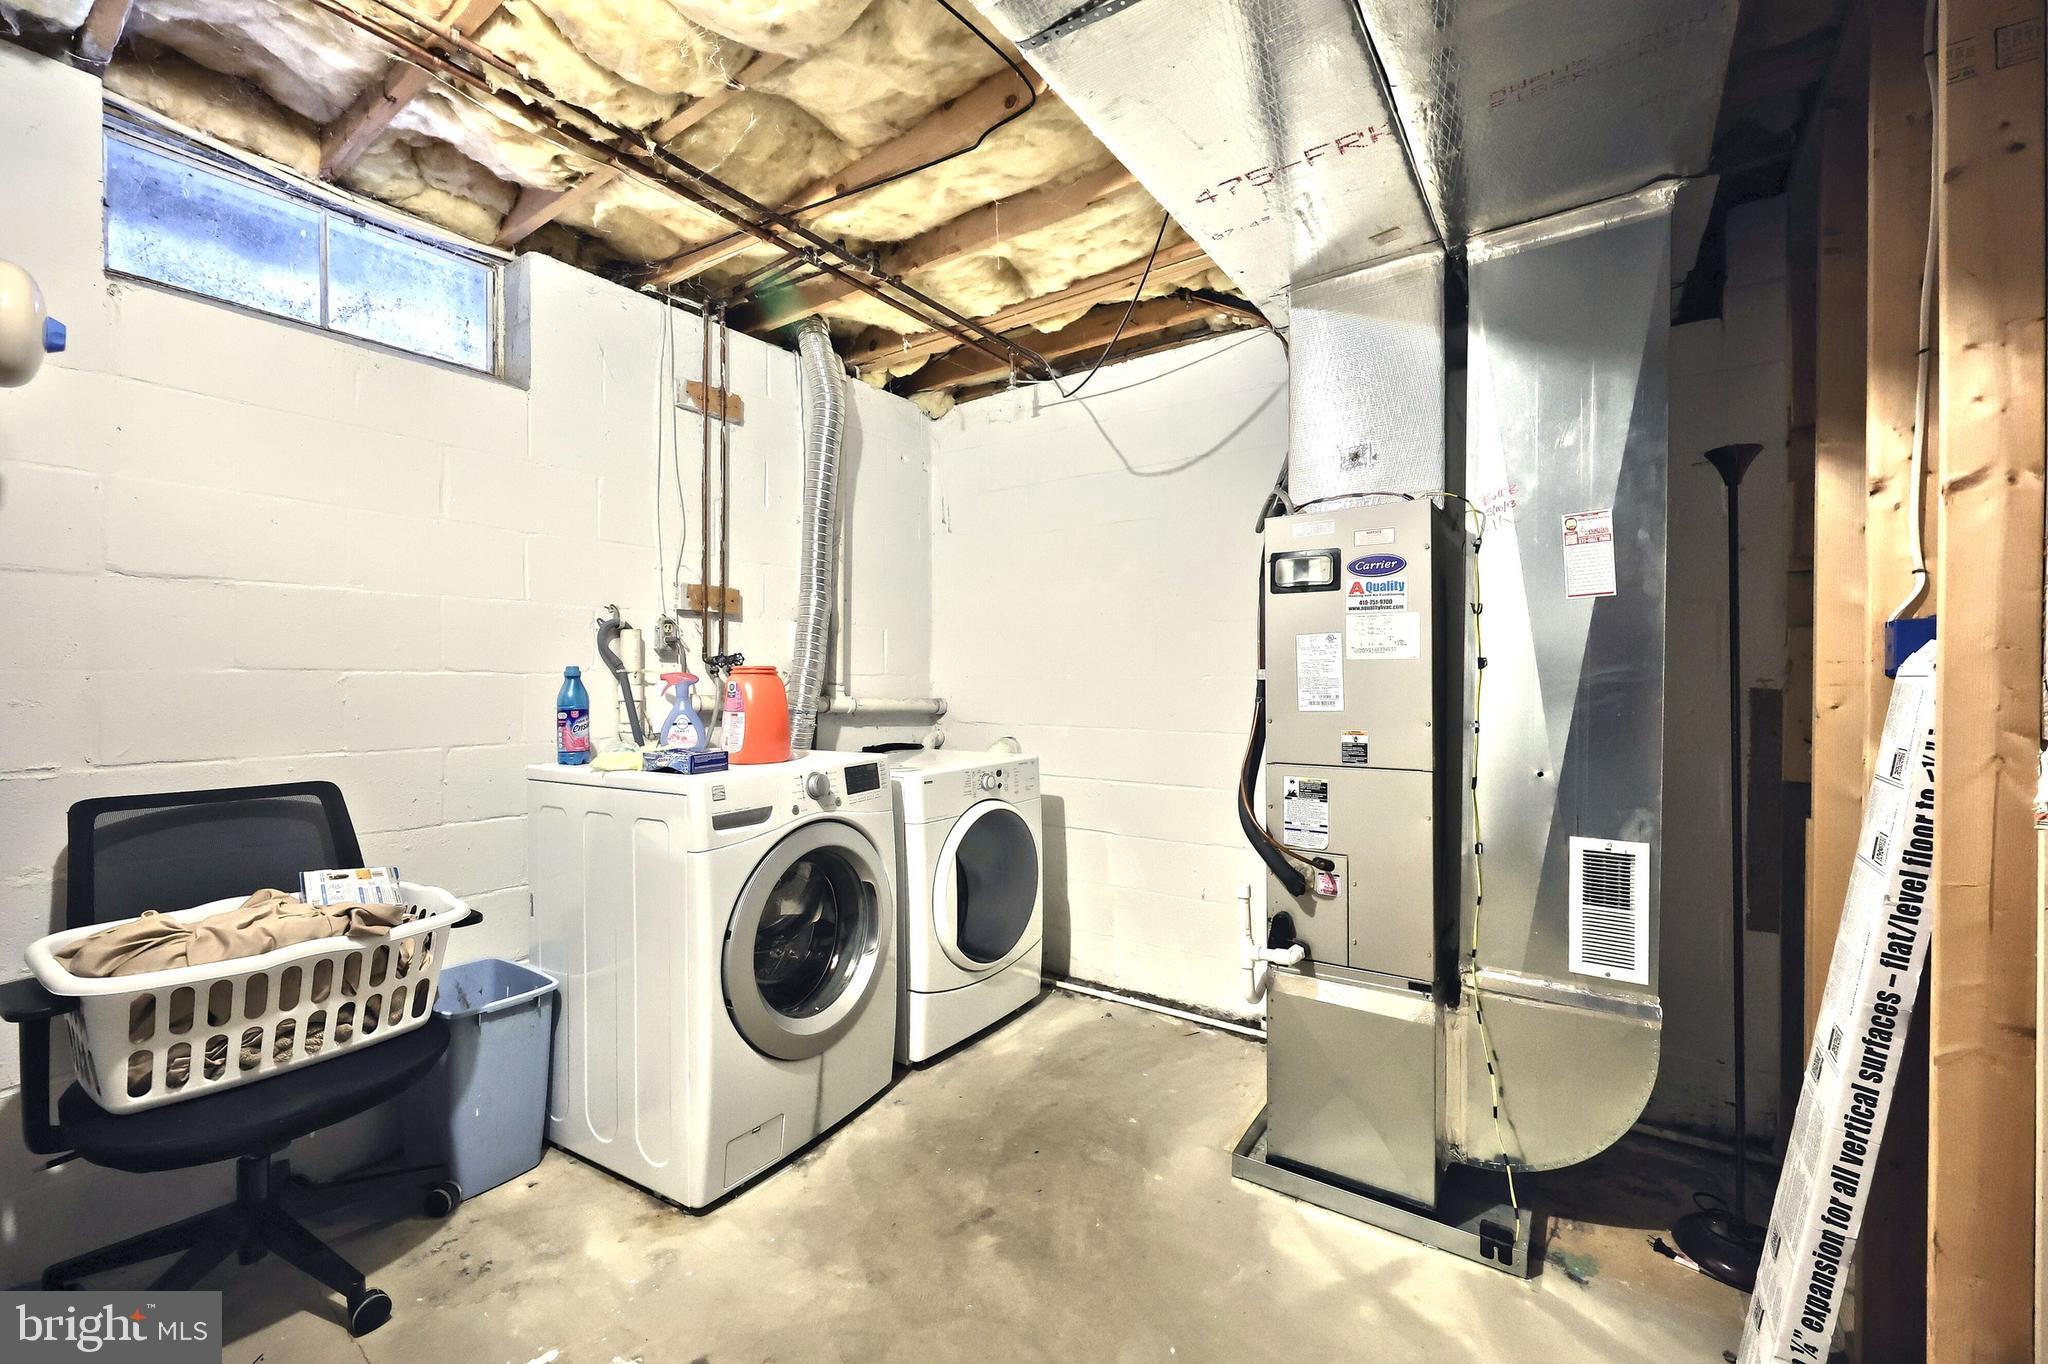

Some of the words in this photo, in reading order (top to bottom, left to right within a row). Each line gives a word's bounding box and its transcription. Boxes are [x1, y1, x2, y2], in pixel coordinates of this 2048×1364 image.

[1349, 581, 1365, 595] A
[1366, 580, 1405, 593] Quality
[1355, 560, 1397, 571] Carrier
[1915, 788, 1934, 810] to
[1902, 814, 1934, 868] floor
[1880, 870, 1929, 971] flat/level
[1859, 990, 1901, 1084] surfaces
[1840, 1083, 1880, 1167] vertical
[1831, 1164, 1861, 1198] all
[1821, 1195, 1853, 1230] for
[1801, 1229, 1845, 1333] expansion
